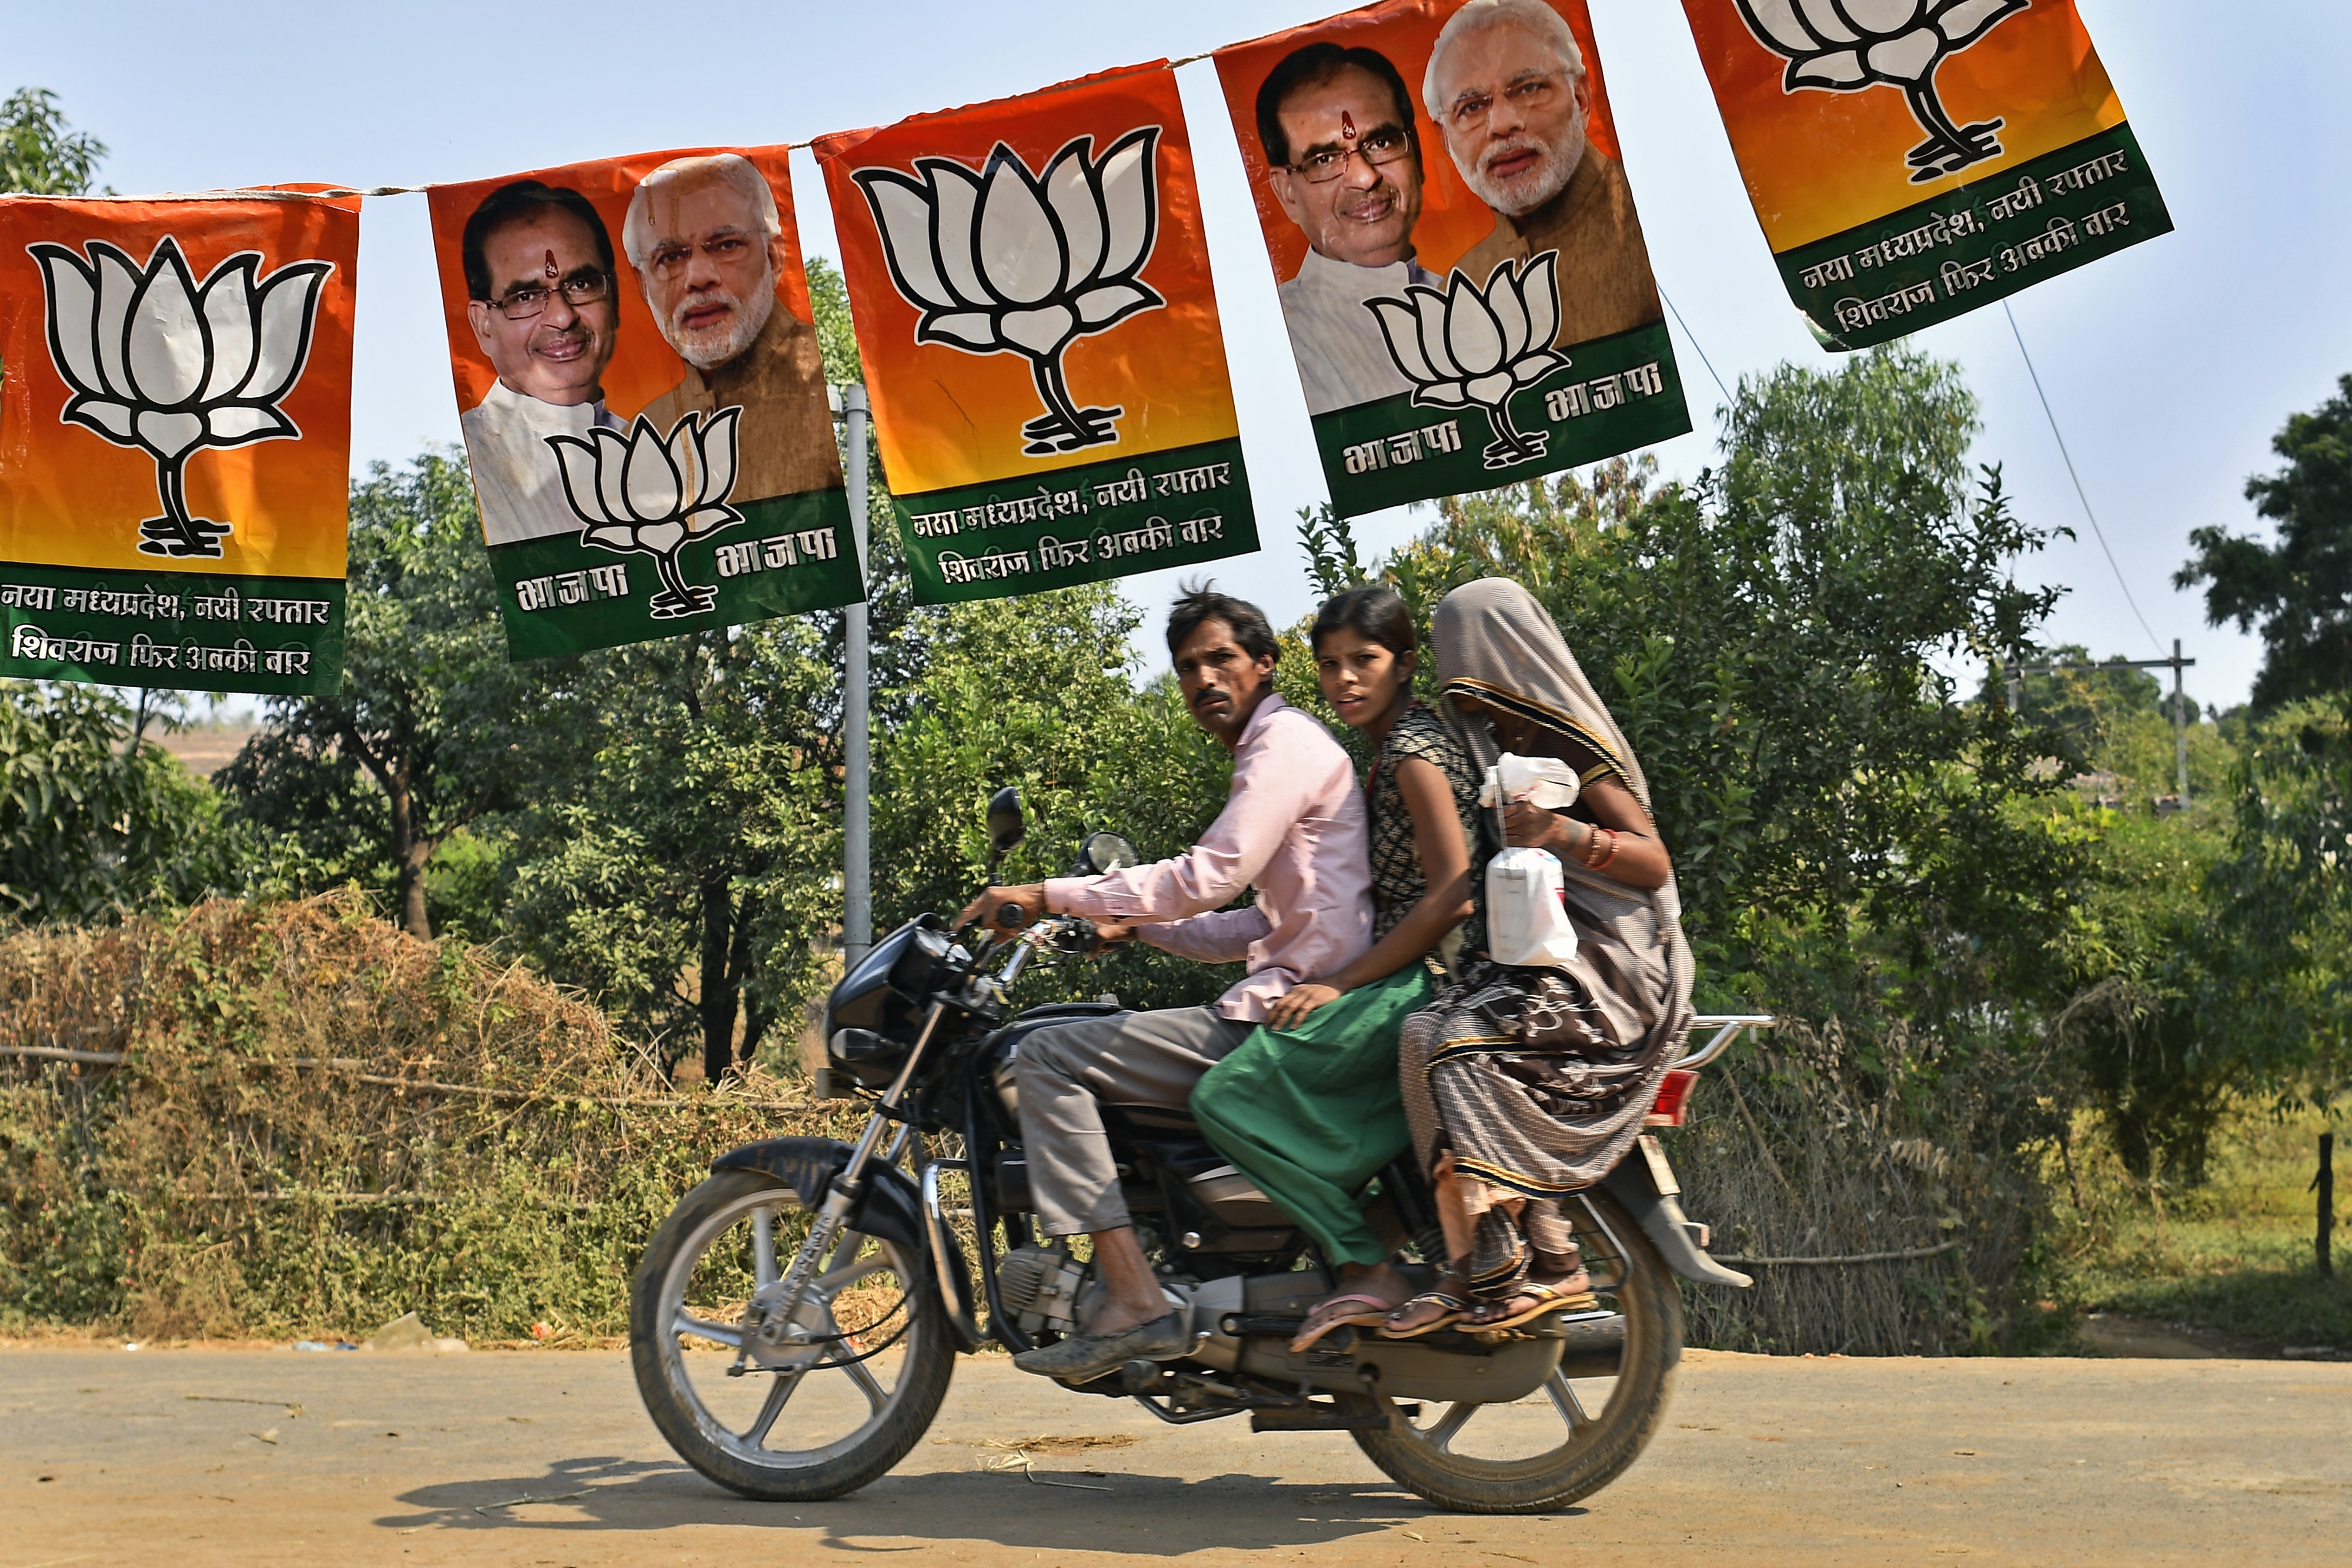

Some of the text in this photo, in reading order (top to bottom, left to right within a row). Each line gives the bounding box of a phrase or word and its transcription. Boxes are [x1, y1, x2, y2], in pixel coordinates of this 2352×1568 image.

[1799, 255, 1855, 289] नया
[1986, 175, 2043, 221] नयी
[2046, 149, 2129, 196] रफ्तार
[1833, 202, 2130, 332] शिवराज फिर अबकी बार
[911, 510, 960, 538] नया
[1093, 467, 1147, 507] नयी
[1154, 462, 1231, 496] रफ्तार
[938, 515, 1224, 584] शिवराज फिर अबकी बार
[1, 584, 55, 610] नया
[194, 587, 240, 620] नयी
[247, 599, 330, 624] रफ्तार
[11, 624, 311, 674] शिवराज फिर अबकी बार
